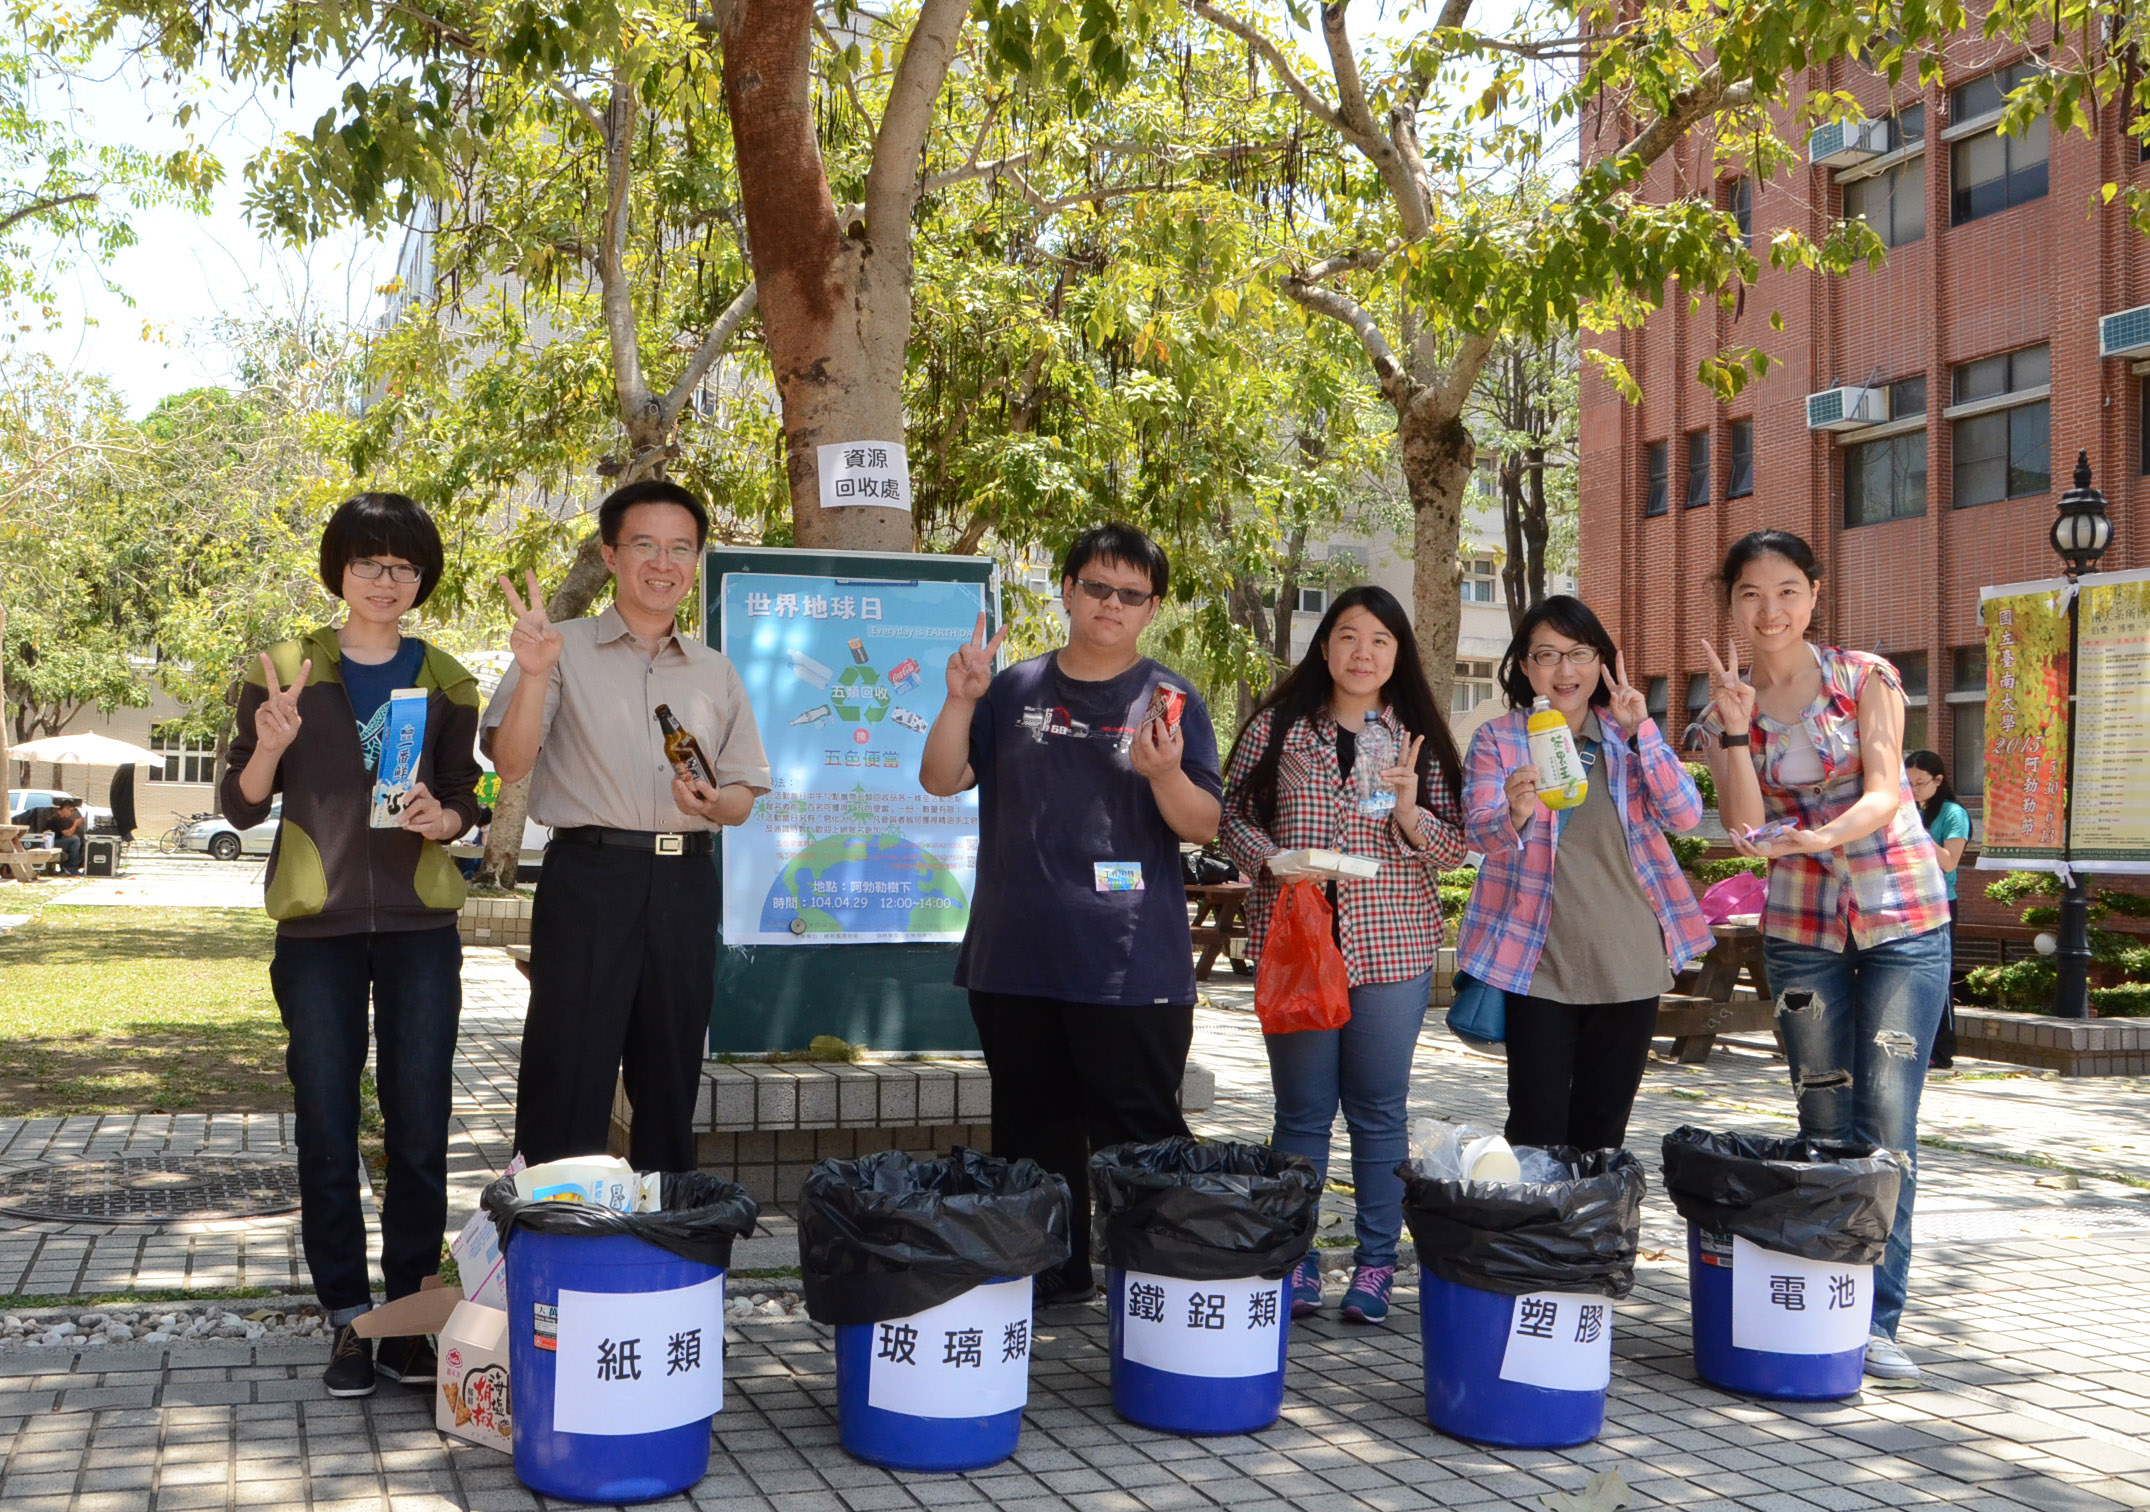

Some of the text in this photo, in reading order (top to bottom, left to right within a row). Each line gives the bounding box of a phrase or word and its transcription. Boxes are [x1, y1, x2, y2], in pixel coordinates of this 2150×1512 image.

[844, 448, 888, 469] 資源
[835, 477, 900, 500] 回收處
[745, 592, 883, 621] 世界地球日
[872, 626, 914, 639] Everyday
[926, 627, 957, 638] EARTH
[960, 629, 973, 640] DA
[1998, 609, 2016, 732] 國立臺南大學
[831, 685, 889, 700] 五類回收
[824, 750, 899, 768] 五色便當
[1994, 736, 2043, 754] 2015
[2021, 756, 2039, 837] 阿勃勒節
[1128, 1281, 1278, 1330] 鐵鋁類
[1770, 1273, 1855, 1311] 電池
[1516, 1297, 1603, 1343] 塑膠
[597, 1327, 702, 1382] 紙類
[877, 1318, 1028, 1368] 玻璃類
